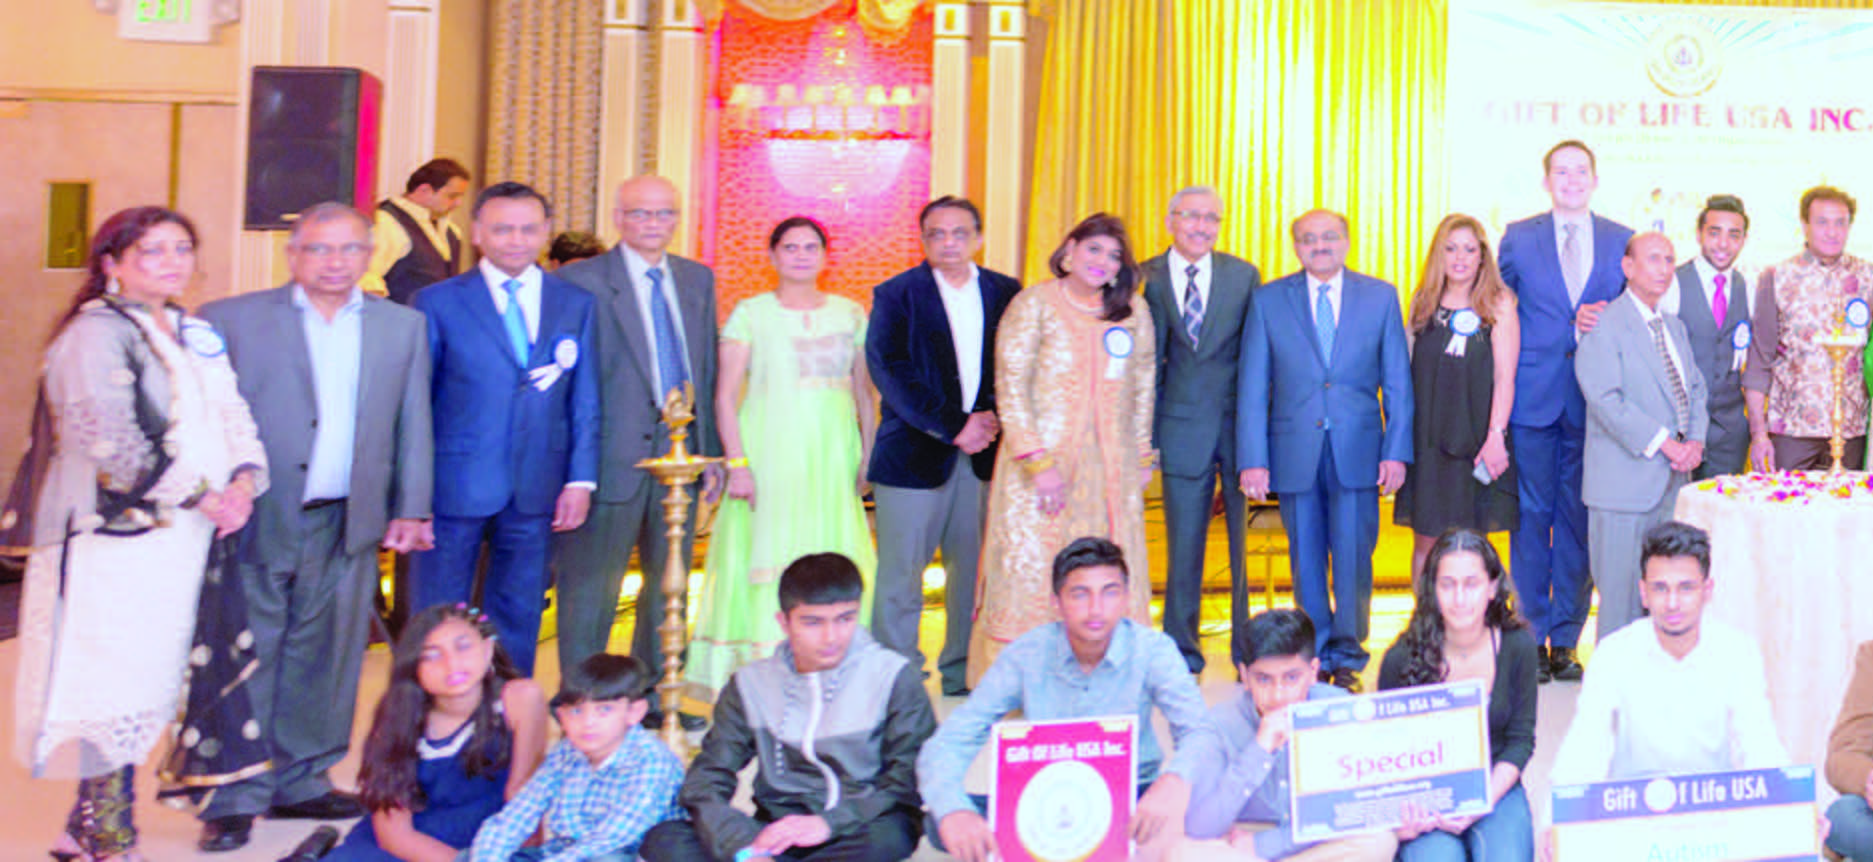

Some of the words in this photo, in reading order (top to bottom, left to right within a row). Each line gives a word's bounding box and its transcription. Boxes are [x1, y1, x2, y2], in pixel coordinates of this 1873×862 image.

[1483, 101, 1562, 127] GIFT
[1580, 101, 1626, 127] OF
[1638, 101, 1706, 128] LIFE
[1726, 104, 1793, 129] USA
[1337, 739, 1443, 782] Special
[1603, 786, 1637, 811] Gift
[1692, 778, 1726, 804] Life
[1732, 775, 1768, 801] USA
[1648, 840, 1729, 862] Autism
